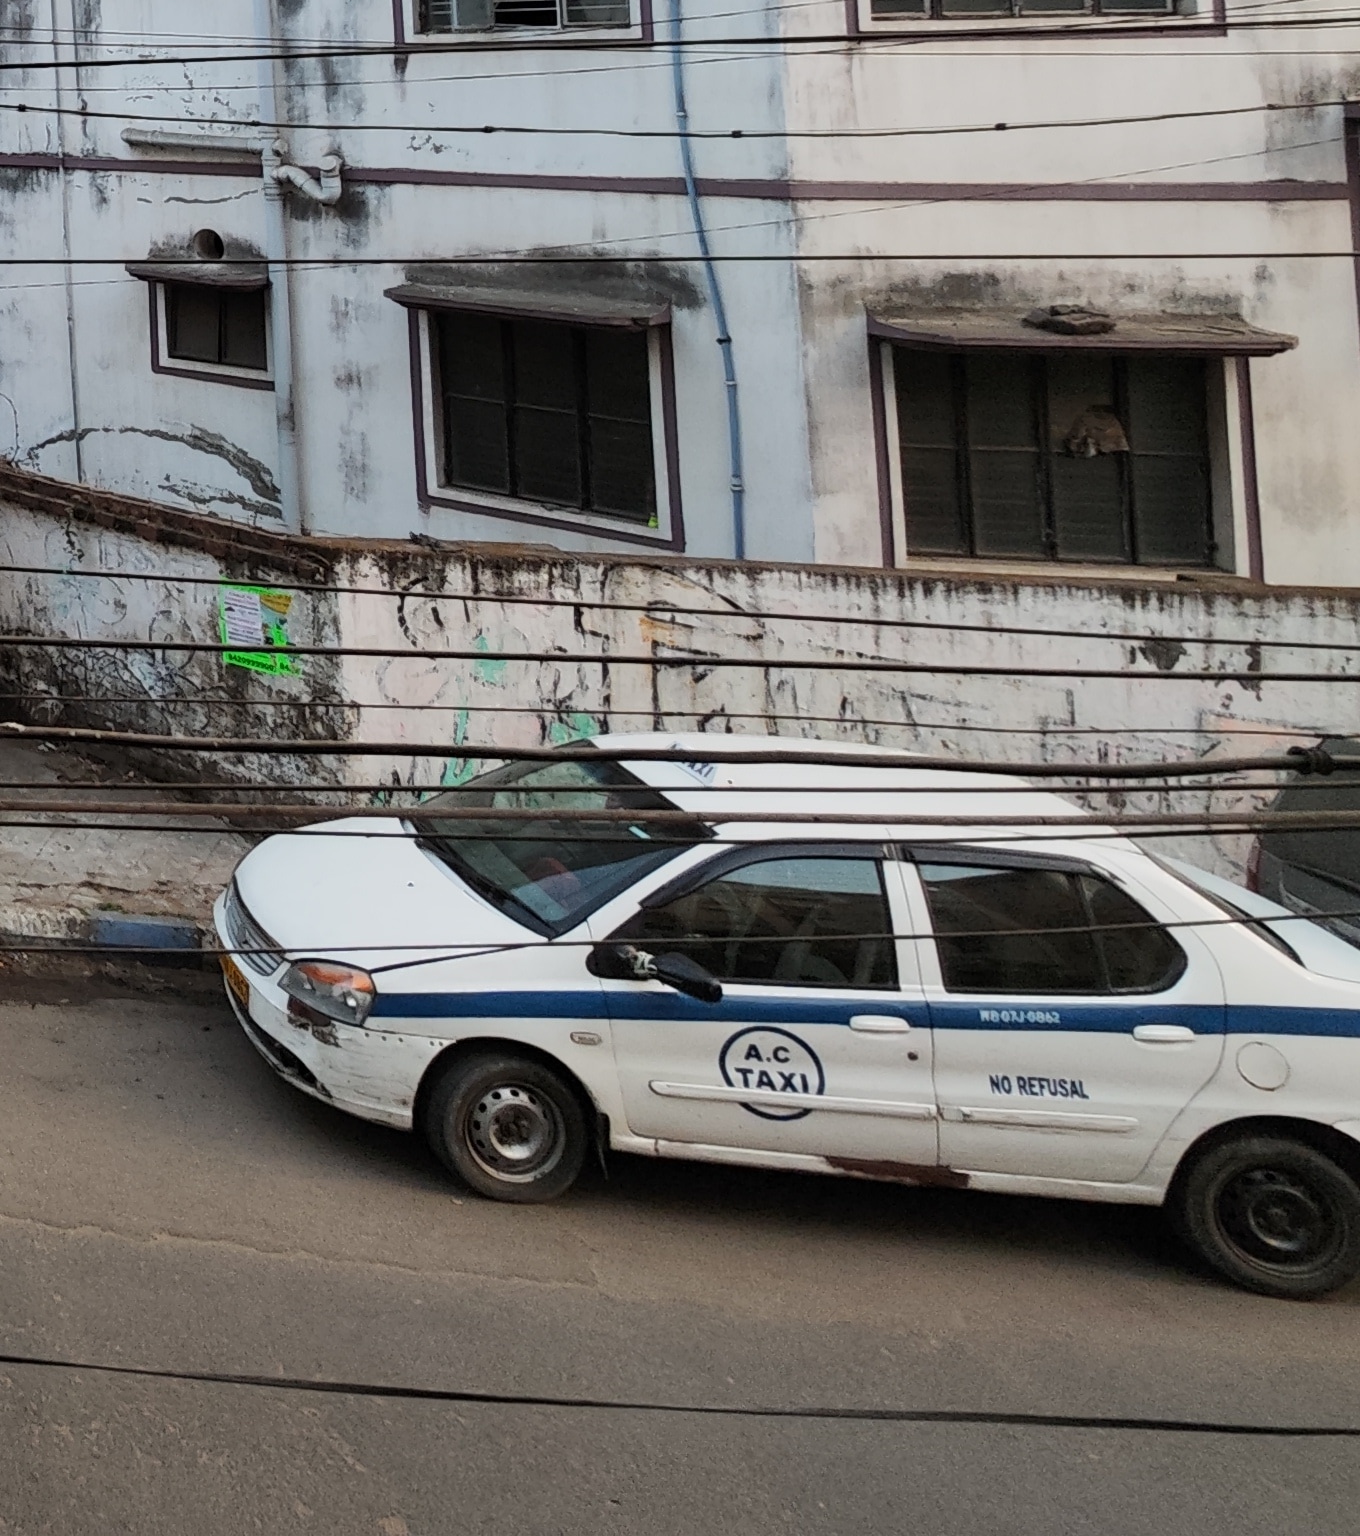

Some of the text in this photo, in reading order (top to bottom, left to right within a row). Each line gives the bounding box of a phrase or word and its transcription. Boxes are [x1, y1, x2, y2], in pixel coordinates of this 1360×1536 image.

[743, 1043, 791, 1064] A.C
[733, 1066, 810, 1095] TAXI
[987, 1074, 1090, 1100] NO REFUSAL
